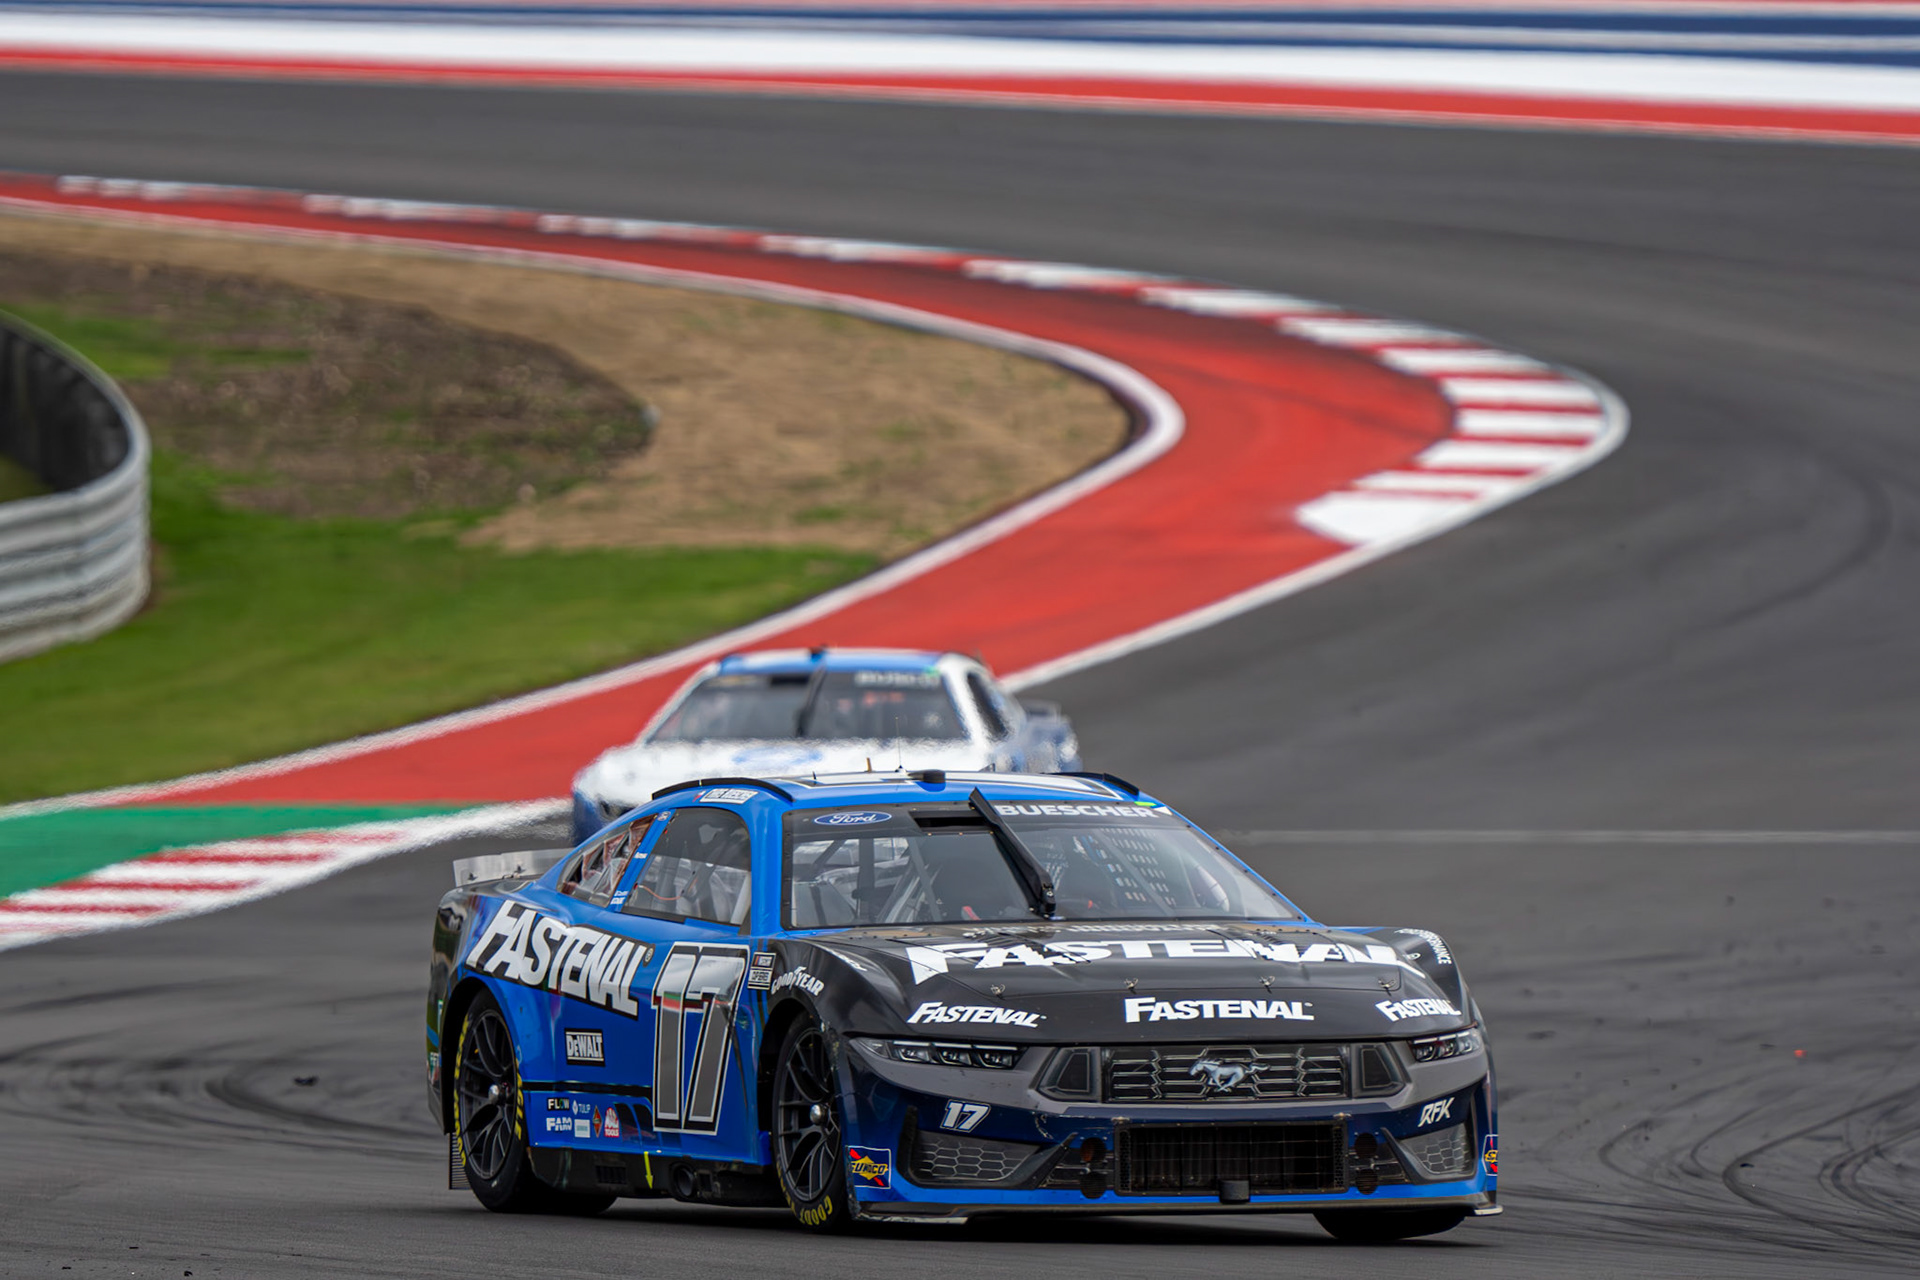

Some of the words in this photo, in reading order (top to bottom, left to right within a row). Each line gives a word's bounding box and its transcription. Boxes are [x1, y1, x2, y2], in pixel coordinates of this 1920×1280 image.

[829, 812, 877, 825] Ford
[995, 804, 1159, 819] BUESCHER
[466, 900, 647, 1017] FASTENAL
[906, 939, 1426, 985] FASTENAL
[771, 966, 824, 996] GOODYEAR
[906, 1001, 1039, 1028] FASTENAL
[1124, 997, 1315, 1023] FASTENAL
[1376, 998, 1462, 1022] FASTENAL
[565, 1034, 603, 1059] DEWALT
[651, 941, 750, 1136] 17
[940, 1100, 991, 1132] 17
[1417, 1097, 1455, 1127] RFK
